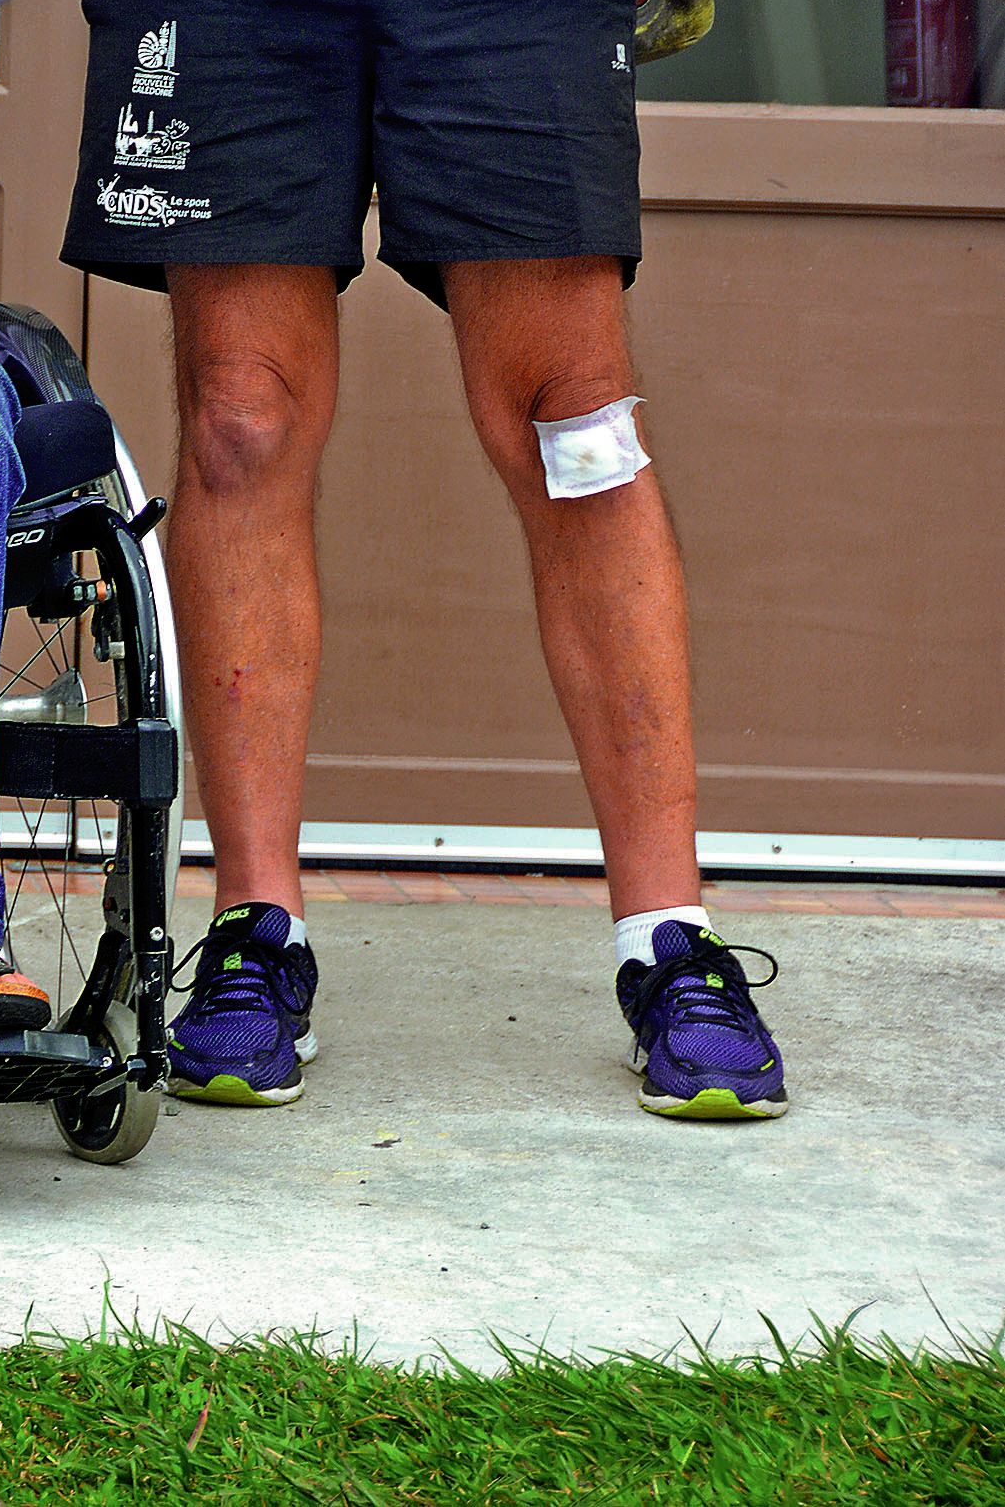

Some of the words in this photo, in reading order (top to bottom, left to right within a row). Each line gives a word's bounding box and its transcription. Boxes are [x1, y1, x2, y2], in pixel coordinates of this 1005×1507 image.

[104, 191, 165, 217] CNDS
[170, 195, 183, 206] Le
[183, 197, 211, 208] sport
[165, 208, 190, 218] pour
[190, 208, 212, 219] tous
[5, 528, 45, 548] eo
